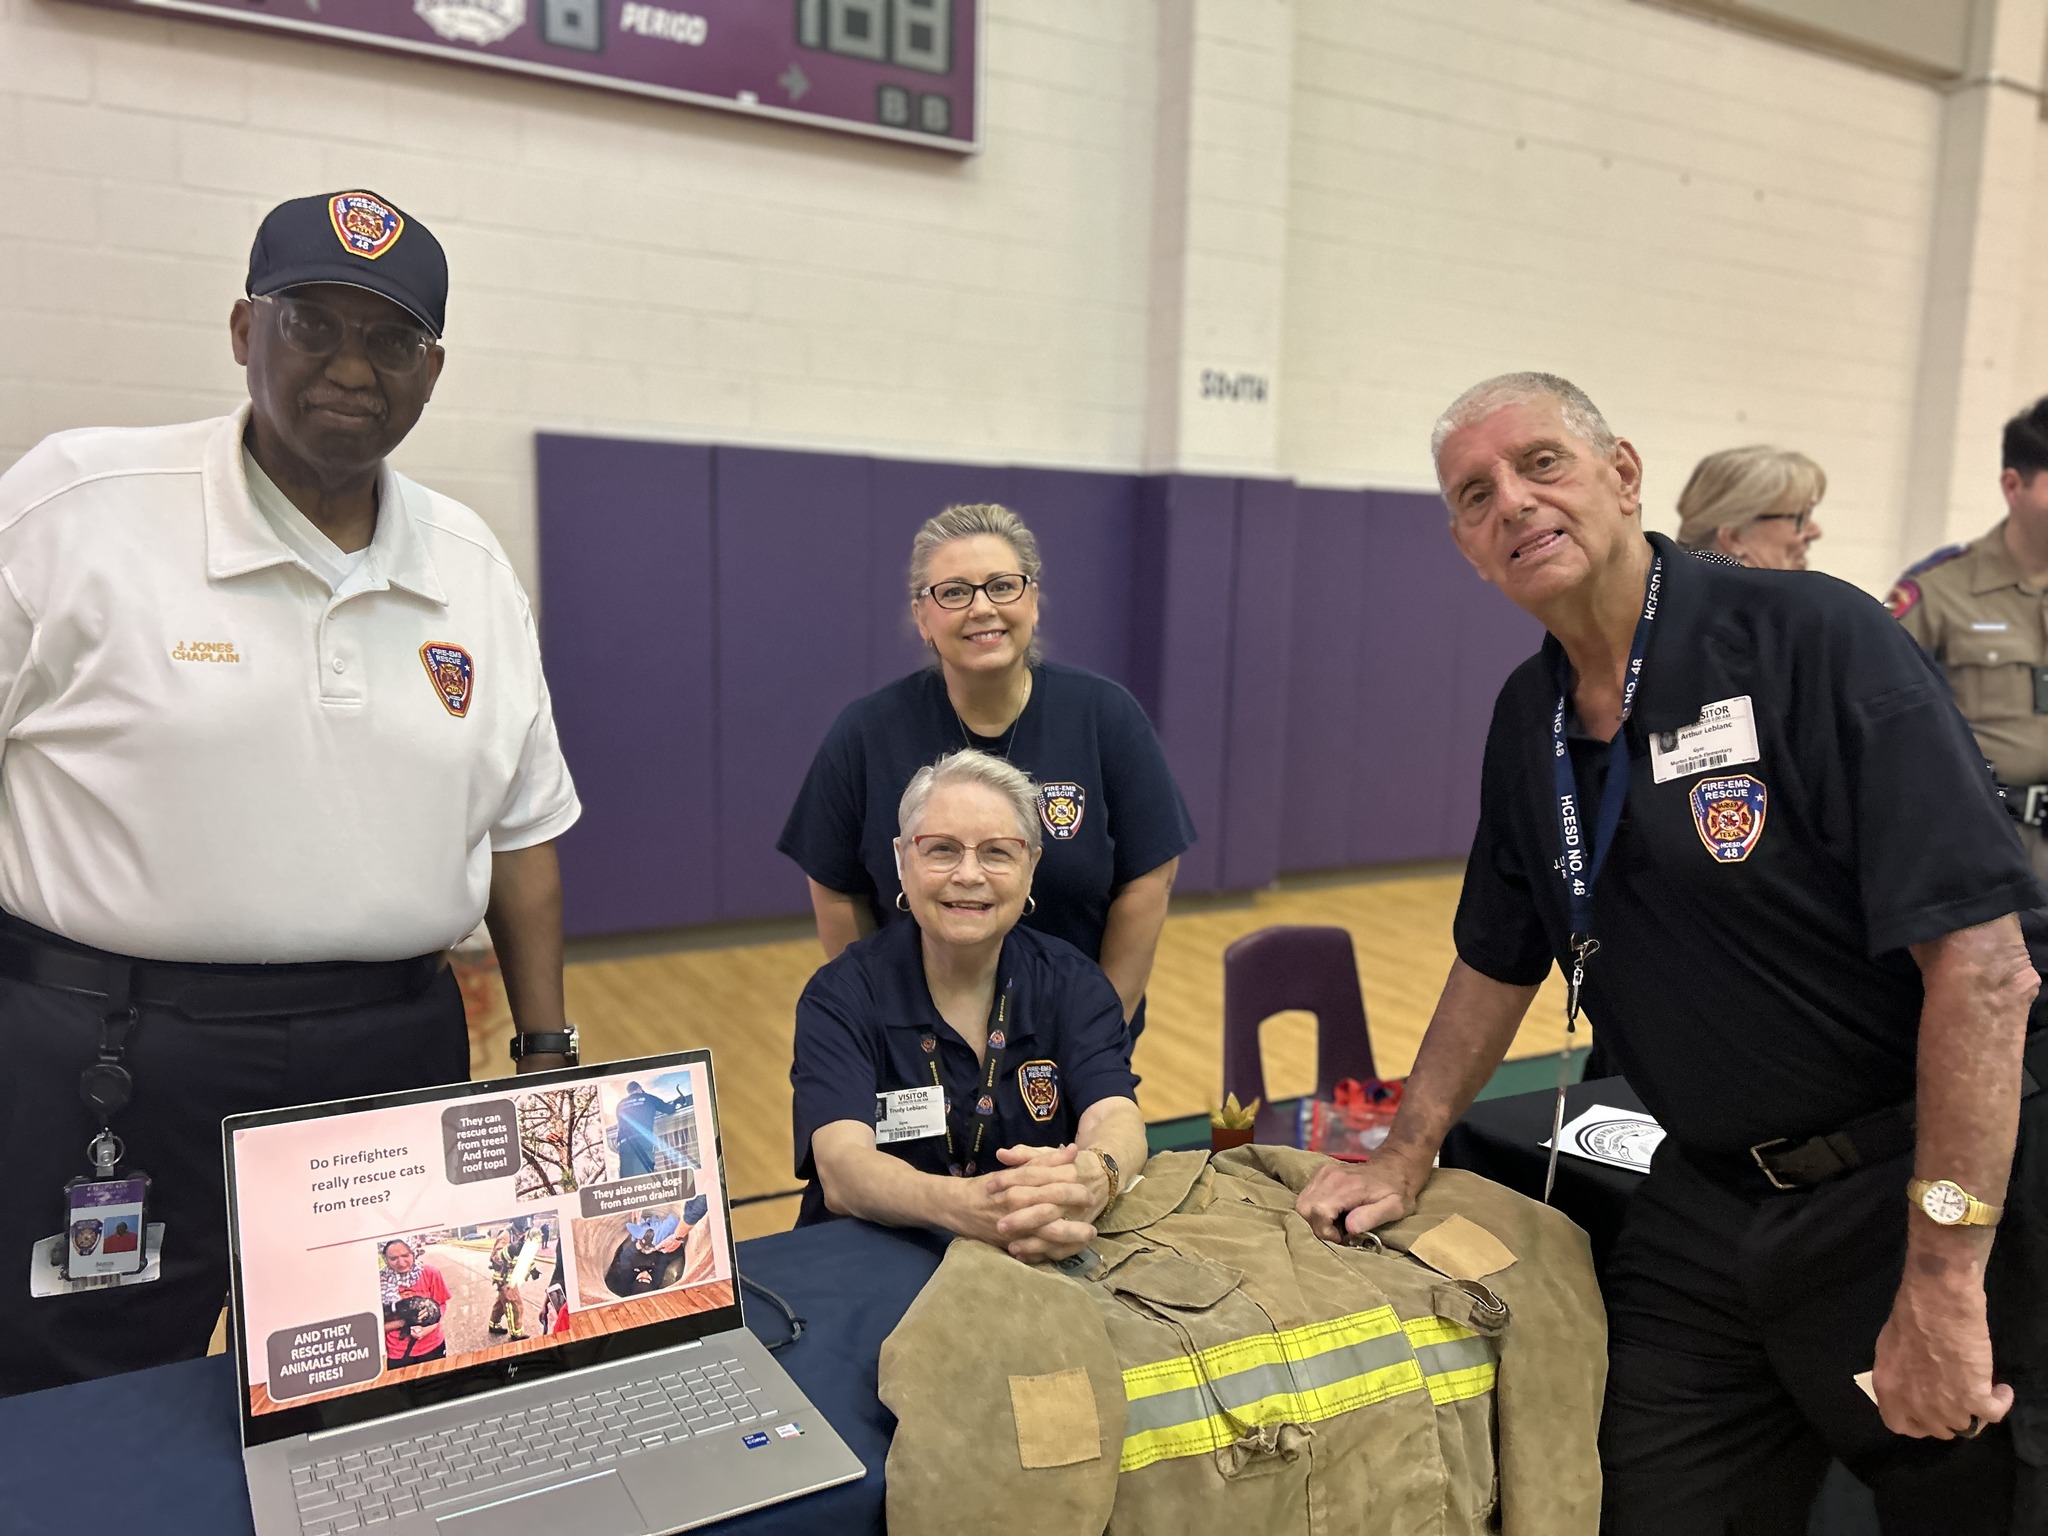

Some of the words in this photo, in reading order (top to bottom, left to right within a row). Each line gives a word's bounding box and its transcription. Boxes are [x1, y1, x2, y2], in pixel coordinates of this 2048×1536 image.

[356, 240, 369, 250] 48
[177, 640, 187, 651] J.
[190, 641, 234, 653] JONES
[172, 650, 240, 663] CHAPLAIN
[436, 655, 462, 665] RESCUE
[1631, 658, 1643, 675] 48
[1625, 678, 1638, 703] NO.
[1700, 705, 1729, 720] SITOR
[1554, 712, 1563, 738] NO.
[1681, 730, 1703, 741] Arthur
[1704, 721, 1732, 734] Leblanc
[1555, 740, 1565, 757] 48
[1701, 780, 1751, 792] FIRE-EMS
[1705, 789, 1749, 800] RESCUE
[1560, 795, 1579, 846] HCESD
[1724, 848, 1738, 858] 48
[1568, 849, 1583, 876] NO.
[1572, 878, 1585, 896] 48
[898, 1091, 928, 1101] VISITOR
[889, 1106, 905, 1114] Trudy
[906, 1104, 928, 1112] Leblanc
[460, 1117, 484, 1128] They
[484, 1114, 501, 1124] can
[457, 1128, 487, 1139] rescue
[488, 1124, 507, 1135] cats
[457, 1140, 480, 1151] from
[481, 1133, 508, 1147] trees!
[310, 1159, 329, 1170] Do
[333, 1146, 408, 1166] Firefighters
[462, 1149, 481, 1162] And
[483, 1147, 506, 1158] from
[463, 1160, 482, 1173] roof
[483, 1157, 508, 1170] tops!
[312, 1176, 349, 1191] really
[353, 1170, 396, 1185] rescue
[399, 1164, 426, 1177] cats
[592, 1189, 615, 1200] They
[615, 1186, 633, 1196] also
[633, 1181, 661, 1193] rescue
[662, 1176, 683, 1188] dogs
[313, 1200, 346, 1214] from
[350, 1190, 391, 1207] trees?
[599, 1199, 622, 1210] from
[622, 1194, 648, 1206] storm
[649, 1187, 678, 1201] drains!
[294, 1331, 321, 1346] AND
[322, 1323, 352, 1339] THEY
[291, 1341, 335, 1360] RESCUE
[336, 1336, 357, 1351] ALL
[280, 1356, 333, 1377] ANIMALS
[335, 1347, 370, 1365] FROM
[308, 1365, 344, 1385] FIRES!
